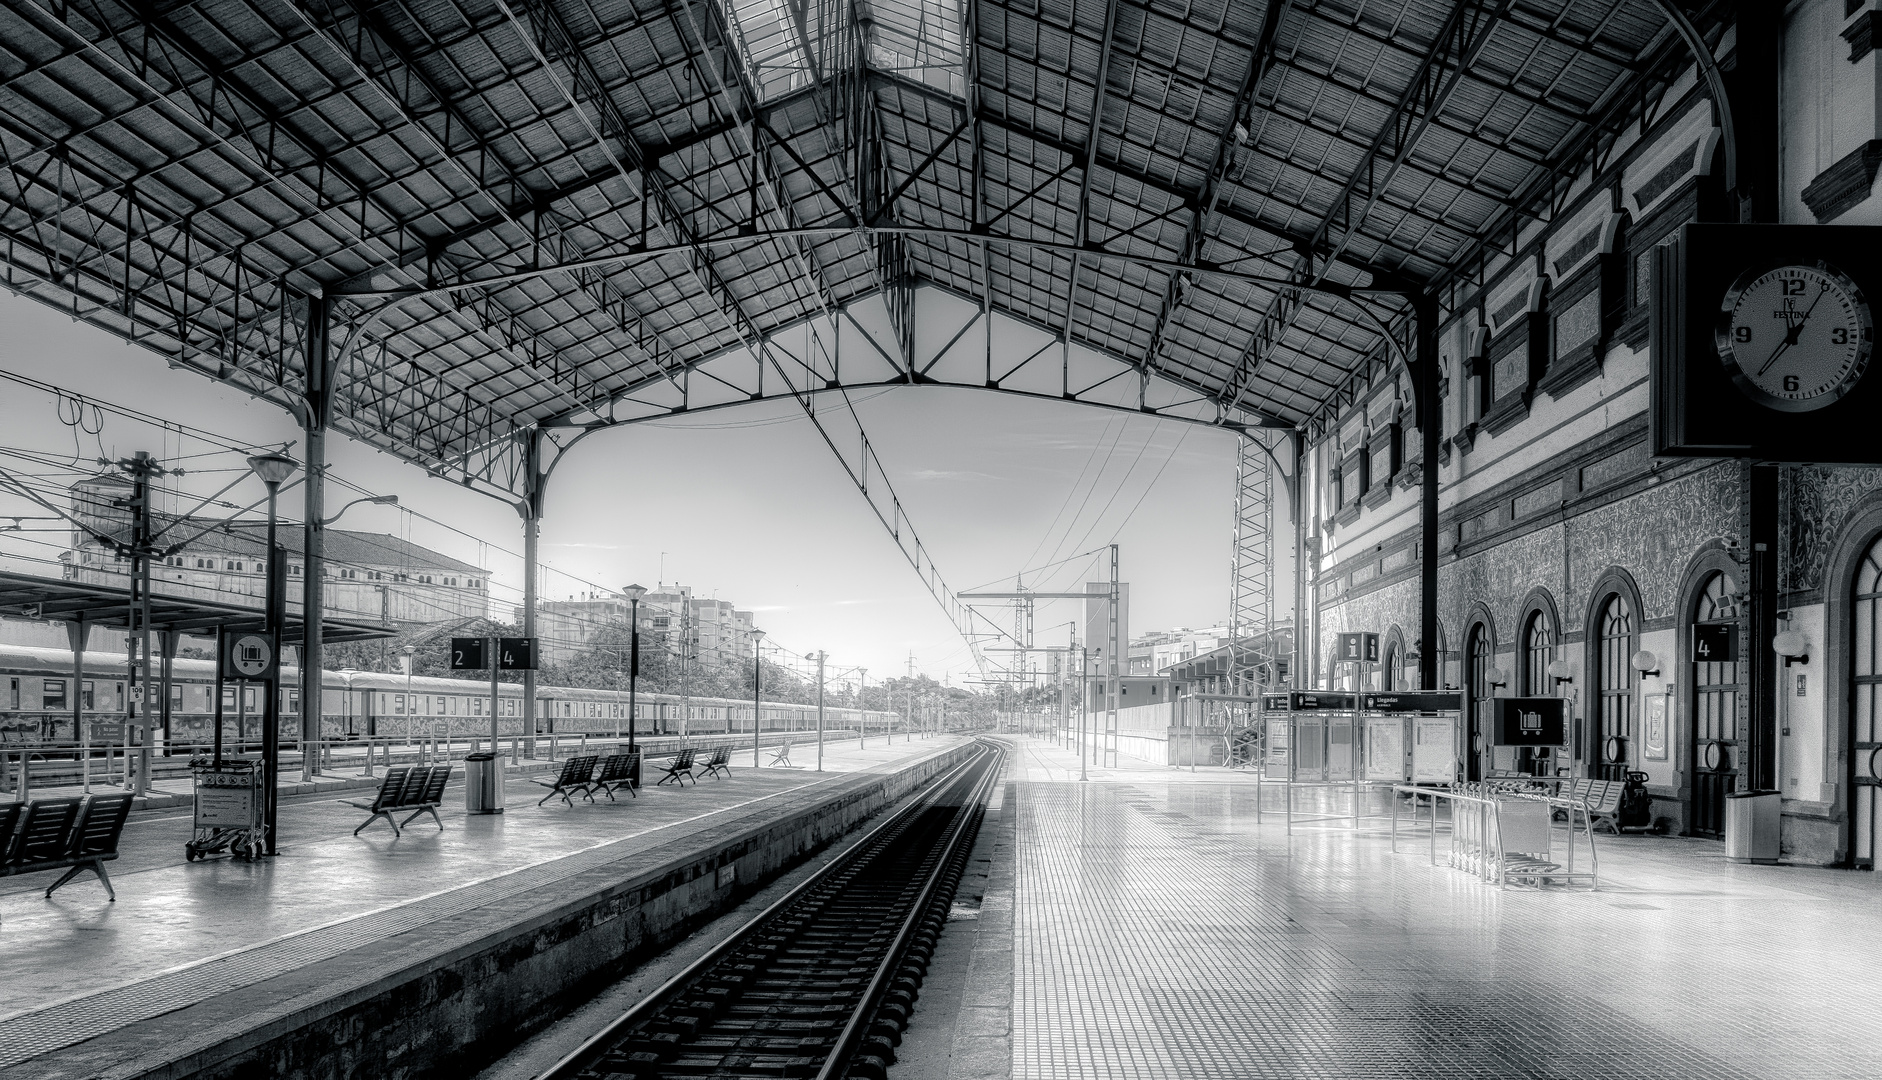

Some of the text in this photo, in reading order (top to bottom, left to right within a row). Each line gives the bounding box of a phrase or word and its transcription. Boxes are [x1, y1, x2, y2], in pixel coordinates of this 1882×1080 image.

[1779, 279, 1806, 296] 12
[1773, 311, 1811, 319] FESTINA
[1735, 326, 1752, 343] 9
[1831, 328, 1848, 345] 3
[1783, 375, 1800, 392] 6
[1698, 639, 1710, 657] 4
[455, 650, 464, 665] 2
[503, 650, 514, 666] 4
